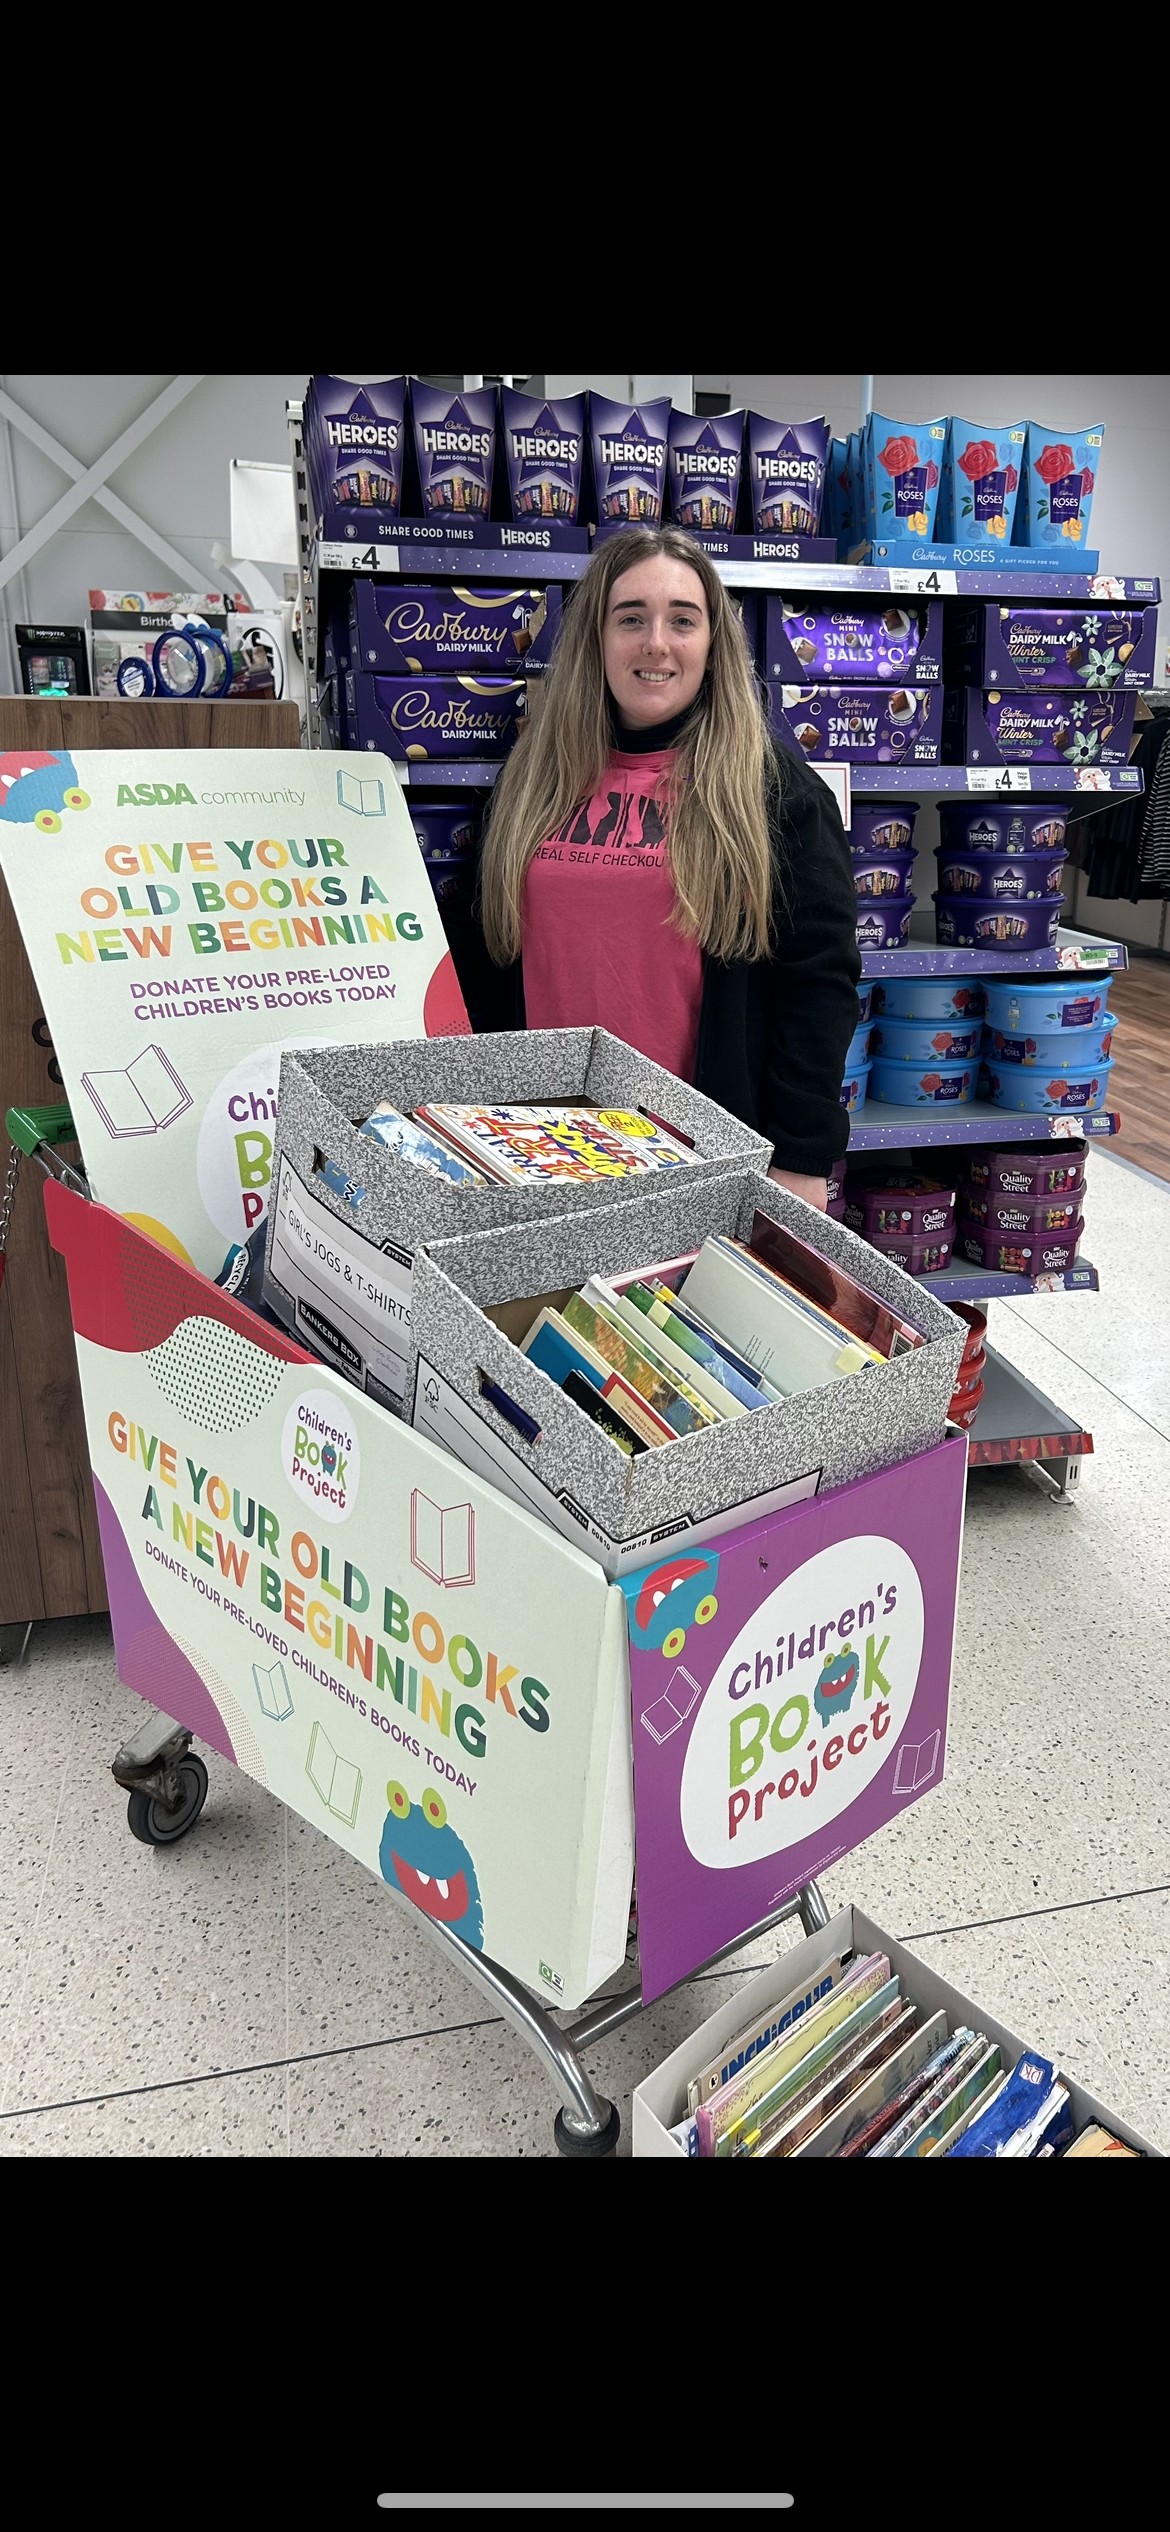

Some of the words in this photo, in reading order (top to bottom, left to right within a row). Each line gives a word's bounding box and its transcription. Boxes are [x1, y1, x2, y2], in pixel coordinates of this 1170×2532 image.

[328, 422, 398, 449] HEROES
[423, 428, 490, 456] HEROES
[512, 435, 578, 462] HEROES
[602, 440, 664, 467] HEROES
[676, 452, 737, 477] HEROES
[758, 458, 816, 482] HEROES
[898, 490, 924, 502] ROSES
[977, 494, 1002, 505] ROSES
[1052, 497, 1078, 508] ROSES
[378, 525, 410, 538] SHARE
[412, 527, 444, 538] GOOD
[446, 529, 474, 540] TIMES
[501, 528, 550, 547] HEROES
[703, 542, 729, 553] TIMES
[754, 542, 799, 559] HEROES
[352, 546, 380, 570] £4
[912, 548, 947, 564] Cadbury
[953, 549, 995, 565] ROSES
[917, 572, 941, 592] £4
[384, 602, 508, 652] Cadbury
[831, 613, 864, 627] Cadbury
[1010, 623, 1042, 635] Cadbury
[824, 633, 873, 647] SNOW
[1010, 635, 1040, 644] DAIRY
[1042, 635, 1068, 644] MILK
[436, 642, 468, 653] DAIRY
[469, 643, 493, 653] MILK
[1007, 644, 1046, 656] Winter
[826, 649, 874, 662] BALLS
[1032, 656, 1056, 664] CRISP
[916, 664, 939, 672] SNOW
[916, 672, 938, 680] BALLS
[838, 697, 870, 710] Cadbury
[391, 690, 511, 739] Cadbury
[1000, 708, 1031, 719] Cadbury
[828, 718, 878, 732] SNOW
[1000, 719, 1030, 728] DAIRY
[1031, 719, 1054, 728] MILK
[442, 730, 472, 740] DAIRY
[474, 730, 497, 740] MILK
[828, 734, 876, 747] BALLS
[997, 728, 1034, 739] Winter
[914, 744, 938, 752] SNOW
[914, 752, 936, 760] BALLS
[995, 769, 1012, 789] £4
[117, 783, 198, 807] ASDA
[201, 788, 306, 807] community
[970, 832, 998, 842] HEROES
[104, 841, 218, 876] GIVE
[224, 838, 349, 870] YOUR
[533, 848, 564, 861] REAL
[568, 851, 600, 864] SELF
[602, 854, 664, 868] CHECKOU
[993, 879, 1023, 889] HEROES
[80, 884, 180, 919] OLD
[192, 876, 348, 912] BOOKS
[360, 876, 390, 904] A
[55, 925, 172, 965] NEW
[188, 912, 424, 955] BEGINNING
[856, 926, 883, 937] HEROES
[130, 978, 220, 999] DONATE
[223, 974, 281, 992] YOUR
[286, 965, 390, 986] PRE-LOVED
[133, 996, 260, 1021] CHILDREN'S
[264, 990, 332, 1009] BOOKS
[336, 985, 398, 1003] TODAY
[951, 1044, 968, 1053] ROSES
[940, 1086, 958, 1094] ROSES
[1066, 1094, 1086, 1102] ROSES
[474, 1116, 605, 1182] ART
[1000, 1172, 1033, 1188] Quality
[1002, 1182, 1030, 1193] Street
[922, 1211, 948, 1226] Quality
[997, 1210, 1031, 1224] Quality
[1000, 1219, 1028, 1230] Street
[924, 1221, 945, 1232] Street
[386, 1248, 411, 1266] SYSTEM
[887, 1254, 908, 1264] uality
[1042, 1248, 1070, 1262] Quality
[1044, 1257, 1066, 1268] Street
[288, 1210, 312, 1248] GIRL'S
[314, 1241, 340, 1273] JOGS
[344, 1265, 354, 1282] &
[356, 1274, 413, 1327] T-SHIRTS
[301, 1304, 339, 1346] BANKERS
[340, 1338, 360, 1368] BOX
[296, 1404, 352, 1452] Children's
[563, 1498, 588, 1528] SYSTEM
[621, 1540, 648, 1554] 00810
[652, 1522, 686, 1543] SYSTEM
[108, 1411, 178, 1489] GIVE
[185, 1456, 281, 1560] YOUR
[290, 1530, 370, 1614] OLD
[383, 1586, 551, 1734] BOOKS
[141, 1484, 164, 1530] A
[172, 1501, 250, 1588] NEW
[260, 1562, 488, 1759] BEGINNING
[728, 1583, 898, 1701] Children's
[144, 1540, 188, 1582] DONATE
[188, 1575, 222, 1608] YOUR
[223, 1596, 288, 1657] PRE-LOVED
[291, 1648, 367, 1718] CHILDREN'S
[370, 1708, 420, 1758] BOOKS
[424, 1747, 478, 1797] TODAY
[721, 2027, 771, 2086] INCH
[778, 1975, 834, 2036] GRUB
[1024, 2063, 1041, 2082] DK
